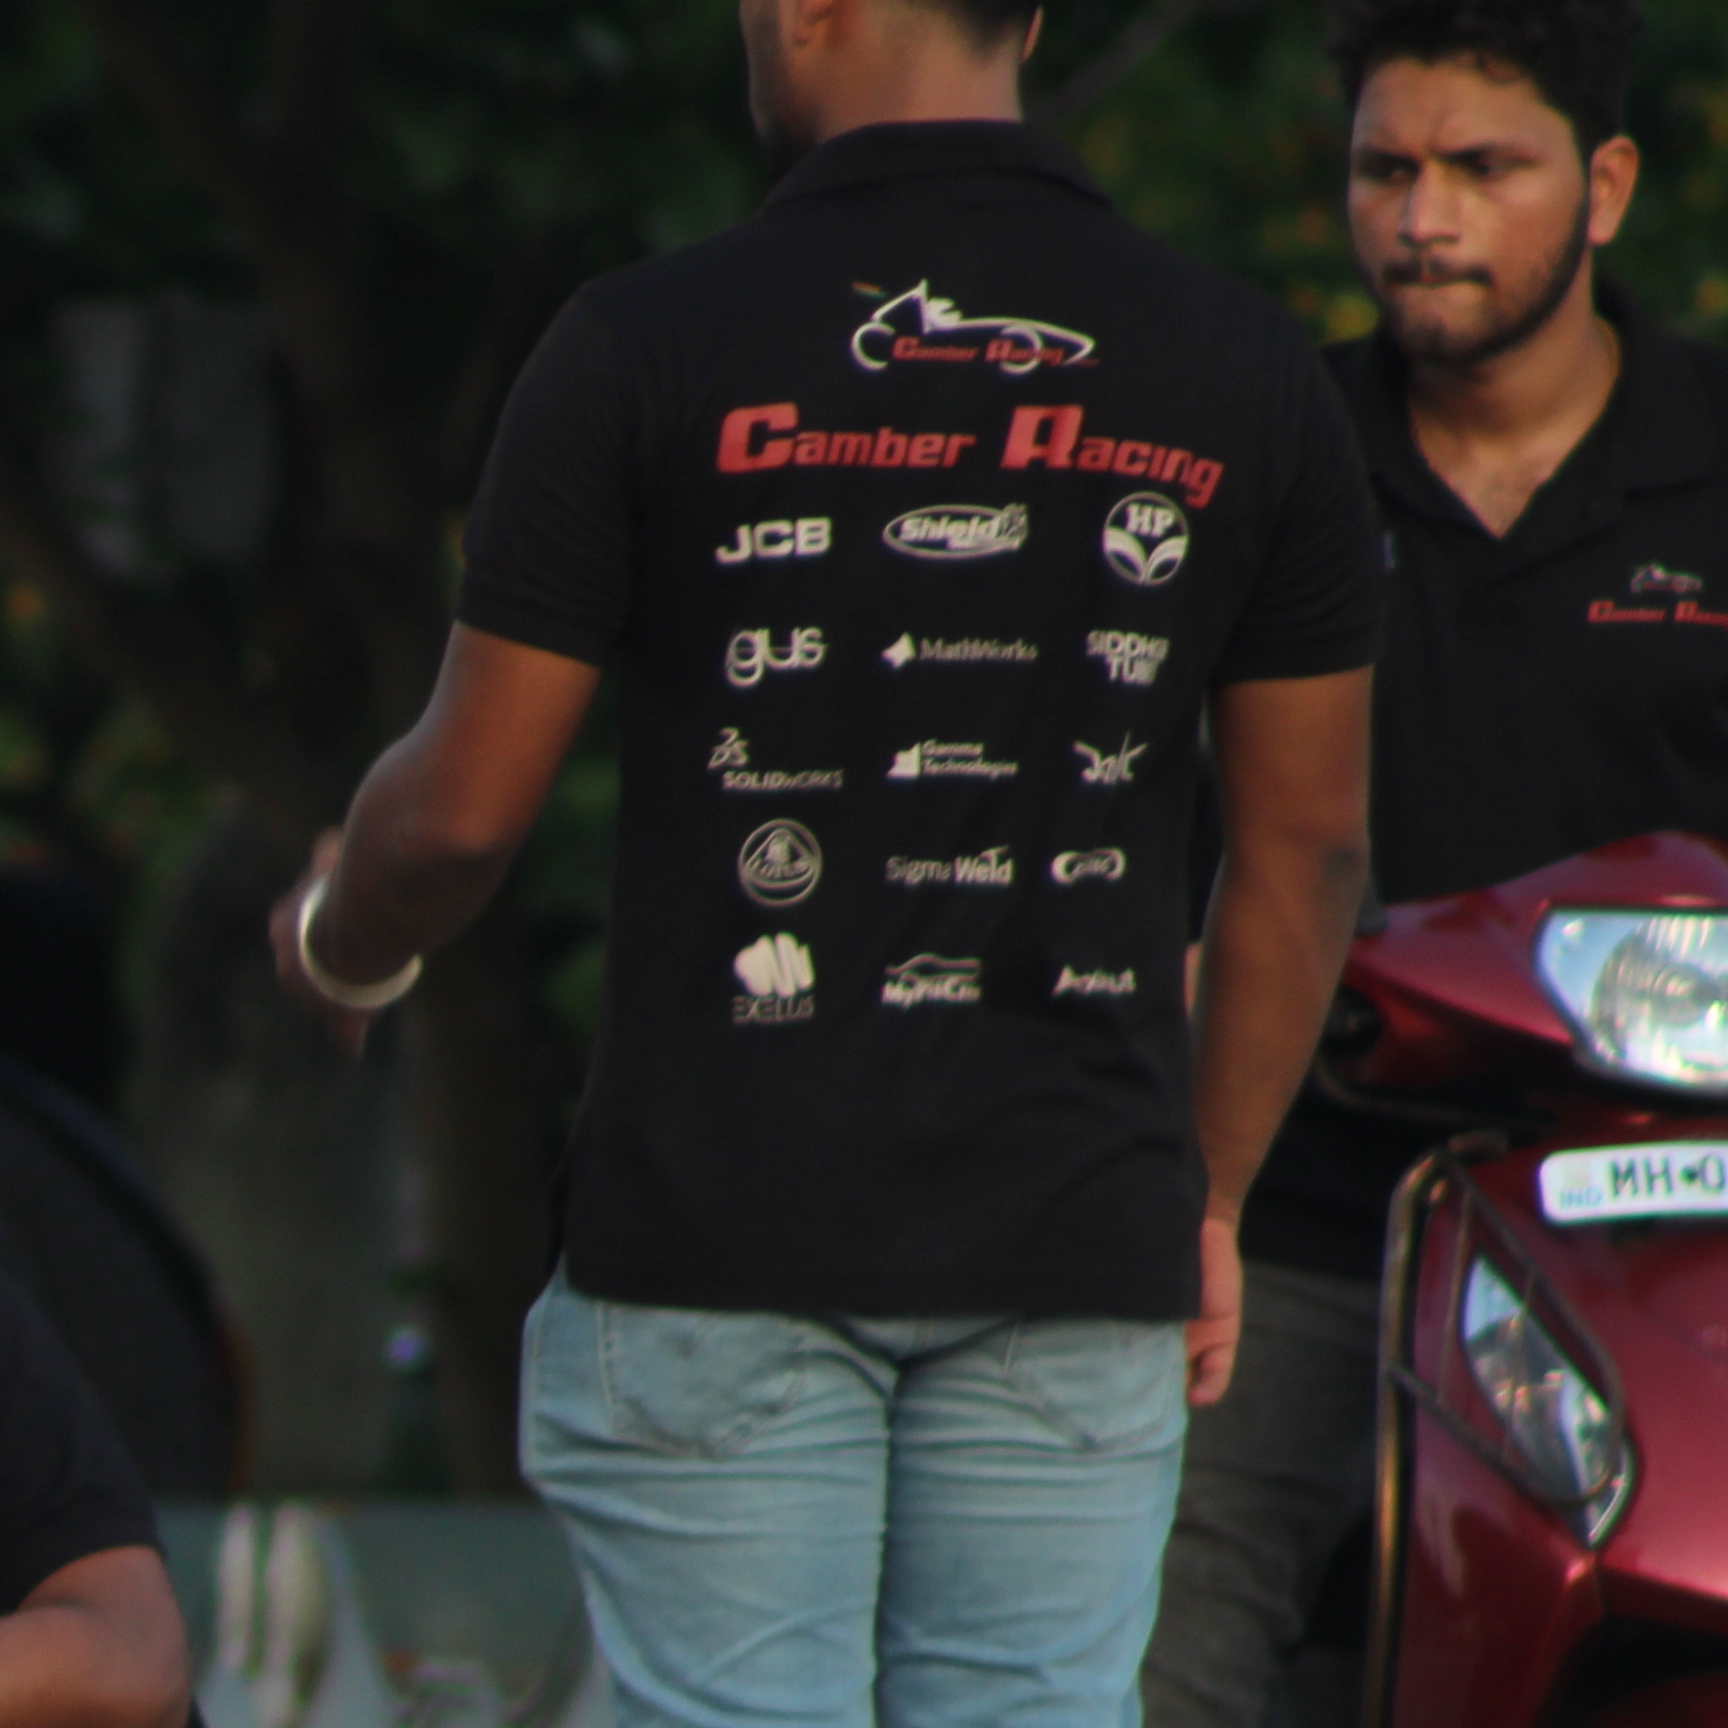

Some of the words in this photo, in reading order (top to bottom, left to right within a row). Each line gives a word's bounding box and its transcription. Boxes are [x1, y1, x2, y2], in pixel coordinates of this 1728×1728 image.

[716, 402, 976, 473] Camber
[1000, 404, 1224, 509] Racing
[716, 517, 831, 564] JCB
[1126, 503, 1176, 537] HP
[1609, 1156, 1672, 1199] MH
